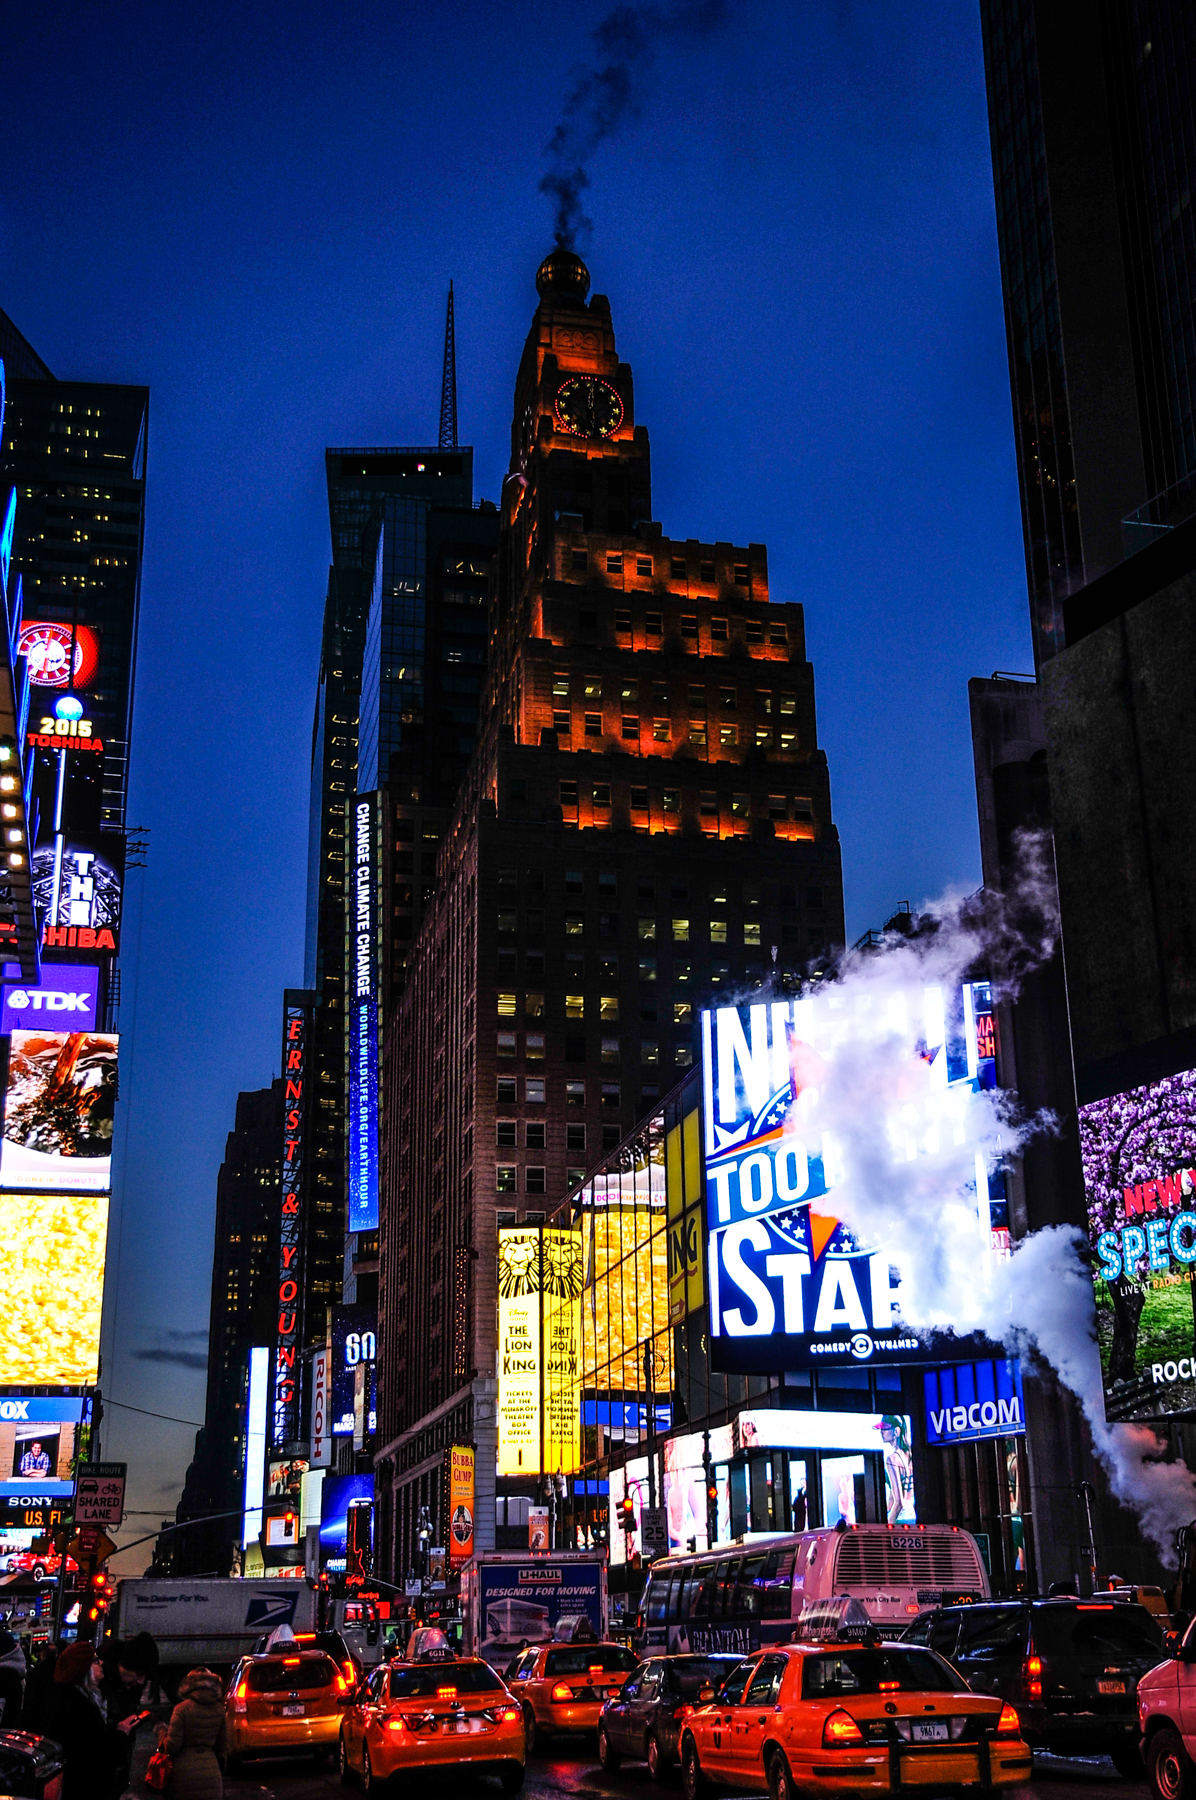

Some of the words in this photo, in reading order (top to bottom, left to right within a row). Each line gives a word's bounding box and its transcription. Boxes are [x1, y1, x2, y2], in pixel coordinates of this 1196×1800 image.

[40, 717, 92, 737] 2015
[27, 733, 103, 751] TOSHIBA
[356, 802, 370, 864] CHANGE
[356, 866, 370, 931] CLIMATE
[356, 933, 370, 997] CHANGE
[27, 990, 92, 1012] TDK
[285, 1020, 302, 1161] ERNST
[359, 1004, 369, 1209] WORLDWILDLIFE.ORG/EARTHHOUR
[59, 1176, 97, 1184] DONUTS
[706, 1141, 810, 1222] TOO
[282, 1193, 299, 1213] &
[1123, 1173, 1183, 1217] NEW
[1097, 1211, 1196, 1281] SPEC
[1120, 1284, 1140, 1297] LIVE
[1140, 1280, 1151, 1292] AT
[1153, 1273, 1182, 1290] RADIO
[278, 1246, 297, 1403] YOUNG
[508, 1325, 528, 1335] THE
[505, 1337, 532, 1353] LION
[809, 1342, 852, 1354] COMEDY
[503, 1355, 536, 1375] KING
[0, 1400, 30, 1419] OX
[313, 1358, 325, 1459] RICOH
[452, 1451, 474, 1467] BUBBA
[81, 1466, 97, 1474] BIKE
[100, 1466, 122, 1474] ROUTE
[453, 1467, 473, 1482] GUMP
[8, 1496, 53, 1507] SONY
[78, 1496, 120, 1507] SHARED
[24, 1510, 45, 1526] U.S.
[84, 1509, 112, 1519] LANE
[644, 1526, 665, 1540] 25
[892, 1537, 922, 1549] 5226
[485, 1587, 534, 1597] DESIGNED
[535, 1586, 555, 1596] FOR
[556, 1585, 597, 1596] MOVING
[847, 1627, 868, 1637] 9M67
